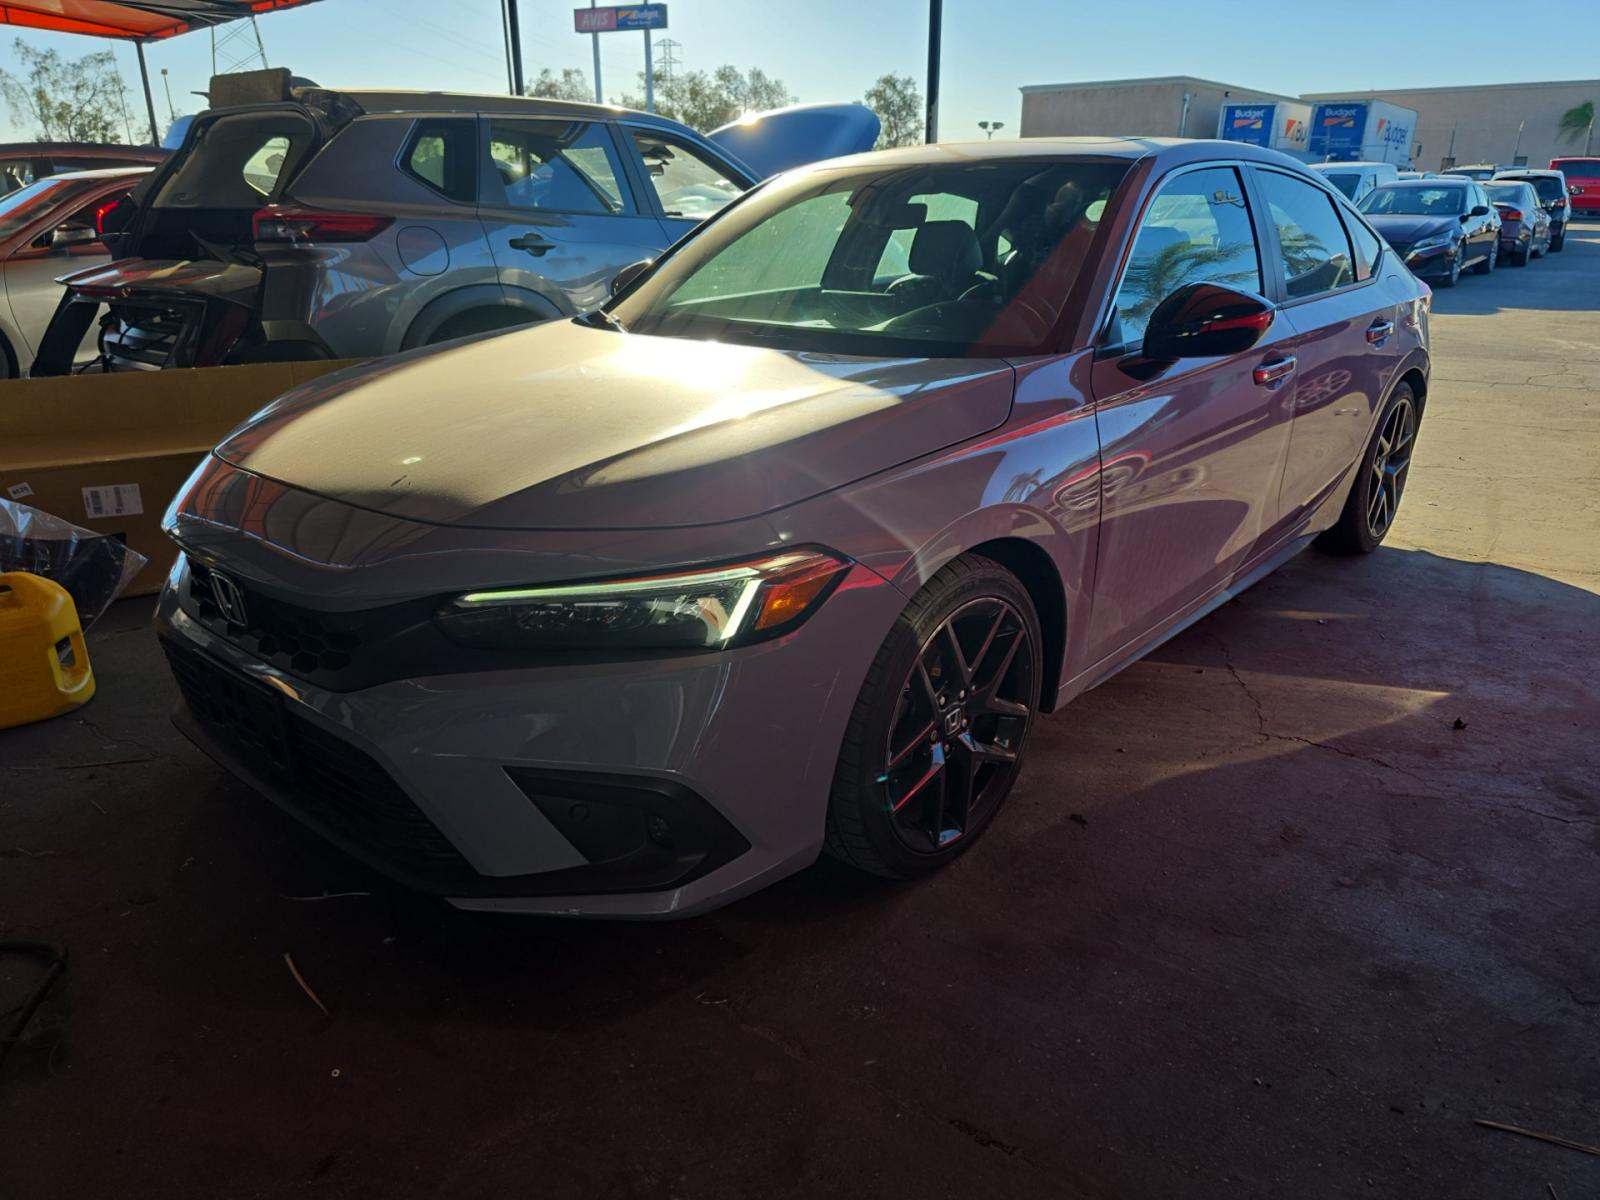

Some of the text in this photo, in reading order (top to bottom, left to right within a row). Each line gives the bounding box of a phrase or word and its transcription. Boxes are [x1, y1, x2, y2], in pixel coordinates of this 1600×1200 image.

[582, 12, 608, 26] AVIS
[1234, 109, 1264, 119] Budget
[1325, 108, 1357, 117] Budget
[1384, 120, 1408, 144] Budget
